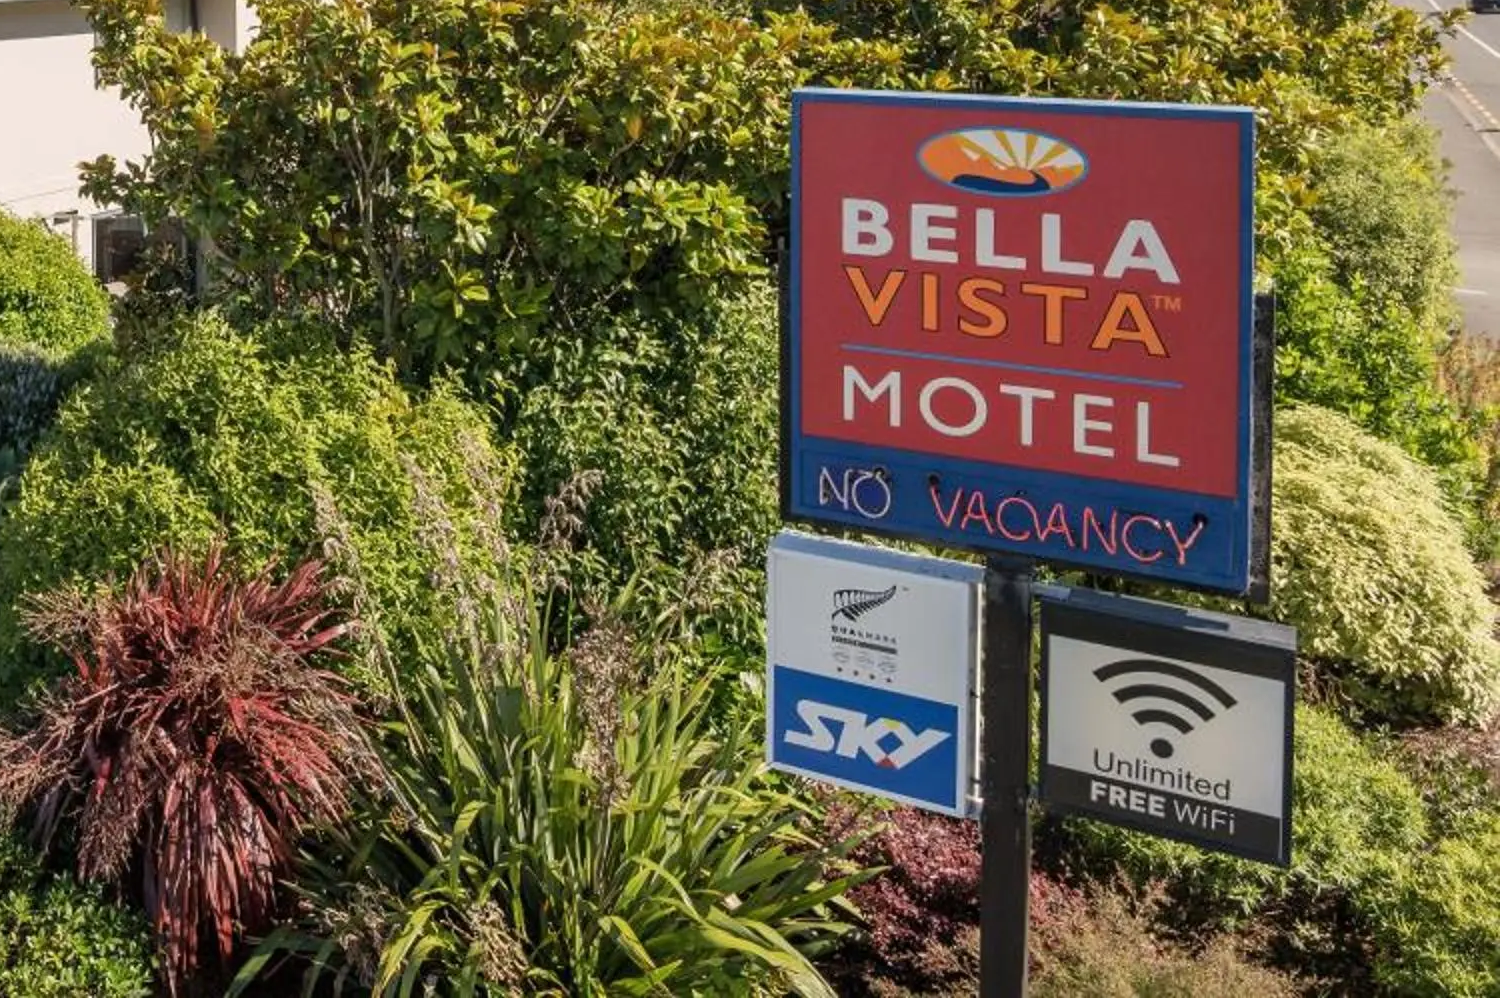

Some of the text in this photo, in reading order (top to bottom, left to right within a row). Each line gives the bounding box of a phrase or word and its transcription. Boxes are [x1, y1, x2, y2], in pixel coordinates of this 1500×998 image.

[841, 198, 1180, 283] BELLA
[842, 264, 1170, 358] VISTA
[843, 365, 1180, 467] MOTEL
[818, 466, 1204, 566] NO VACANCY
[783, 699, 952, 770] SKY
[1093, 748, 1231, 801] Unlimited
[1090, 779, 1236, 835] FREE WiFi
